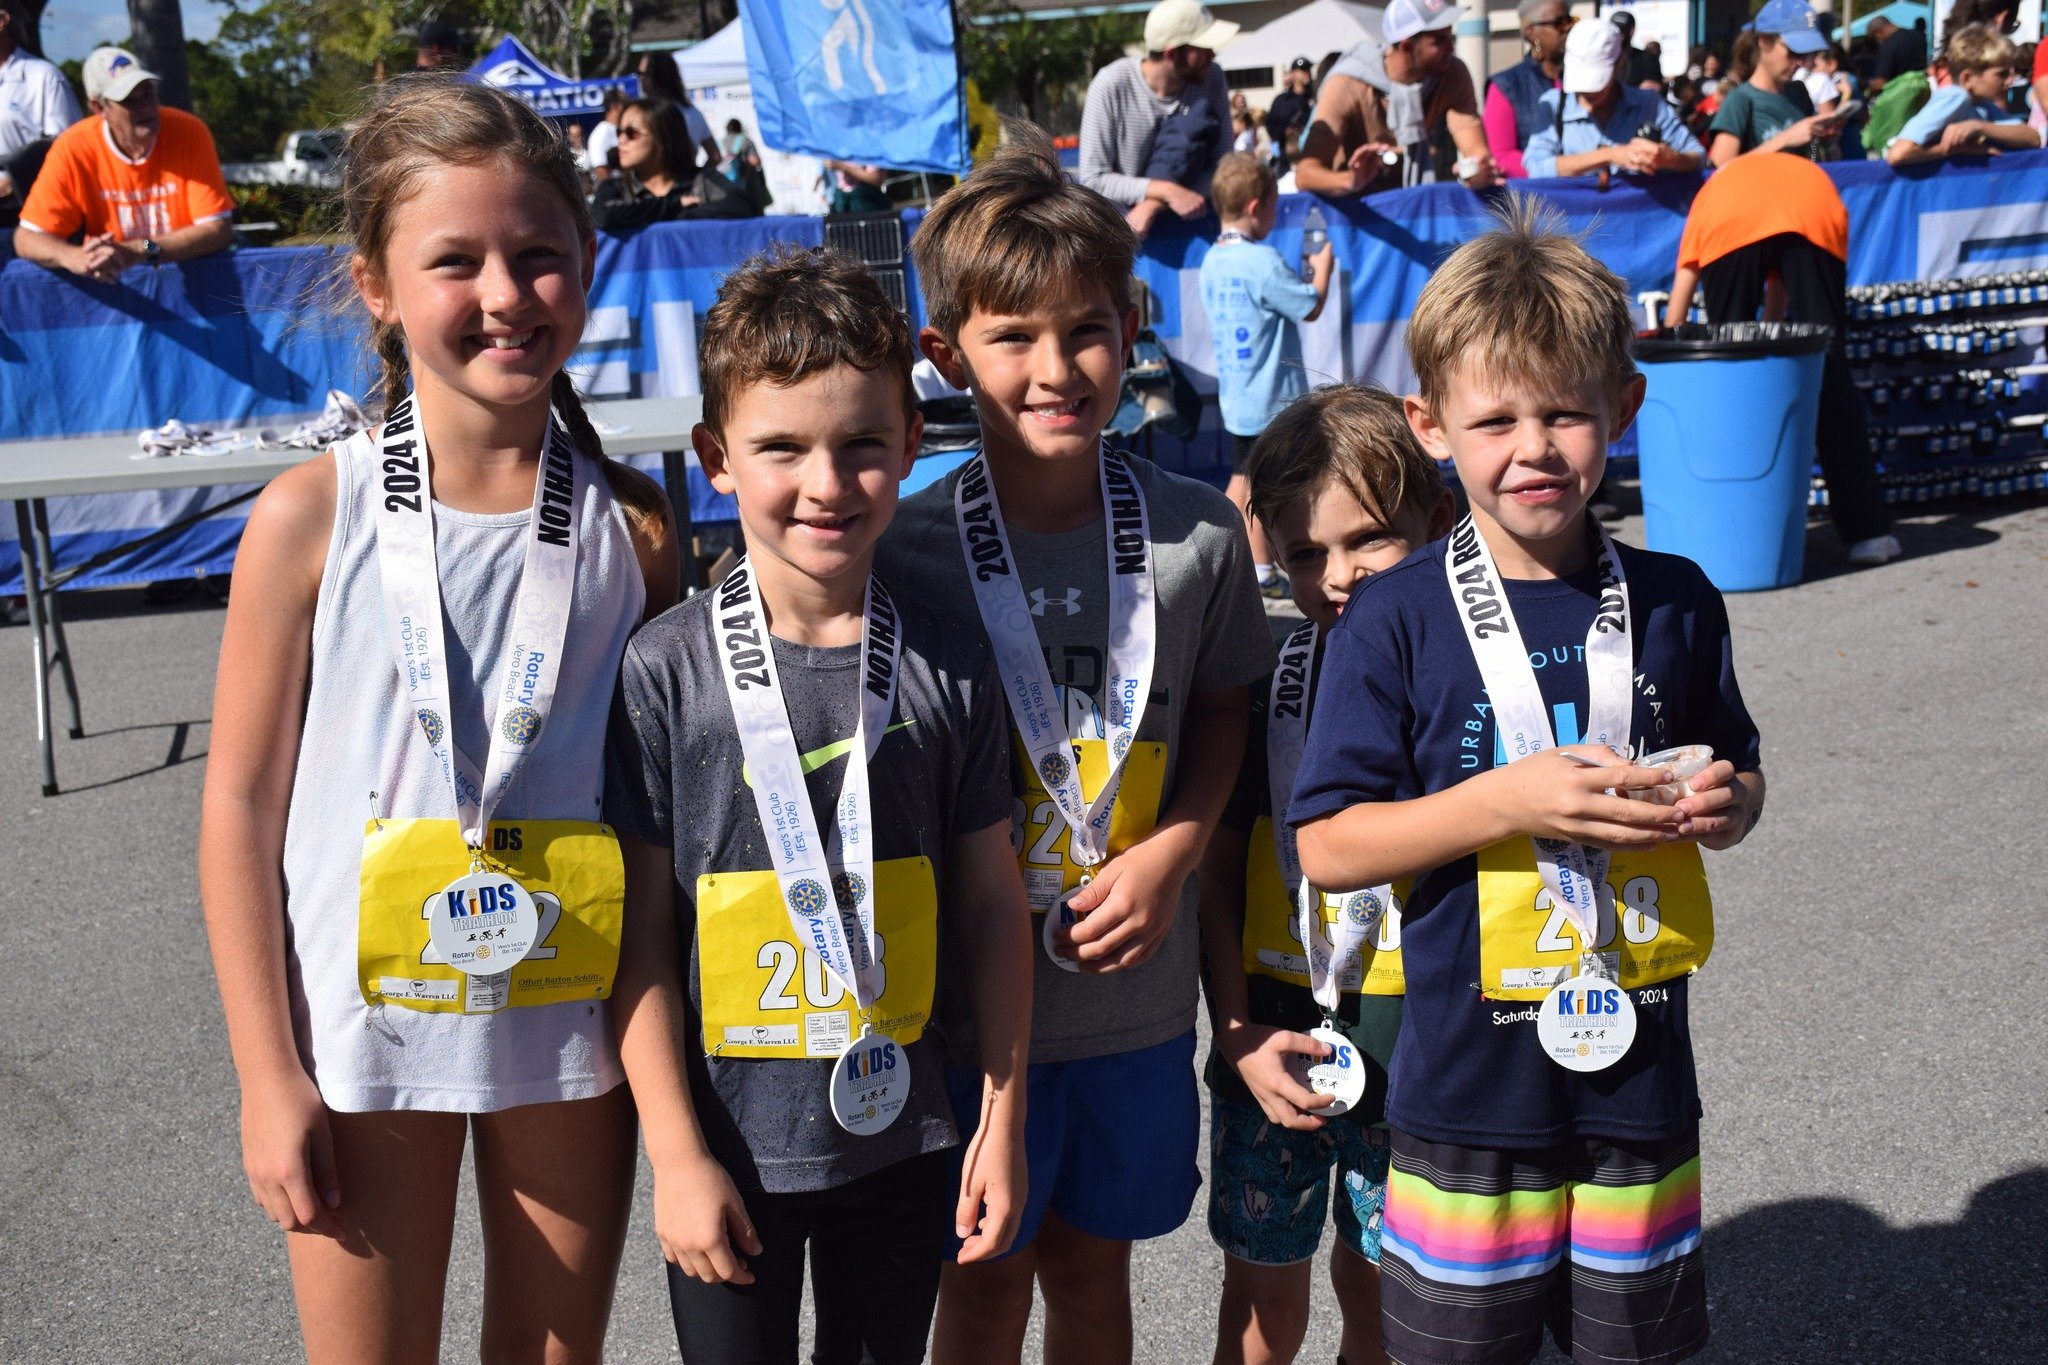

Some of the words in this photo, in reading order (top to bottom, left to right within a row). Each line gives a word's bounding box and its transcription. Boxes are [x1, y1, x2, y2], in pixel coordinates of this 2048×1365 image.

[522, 82, 626, 111] ATIO
[383, 392, 415, 439] RO
[382, 439, 422, 513] 2024
[961, 452, 989, 505] RO
[962, 501, 1011, 582] 2024
[720, 557, 752, 611] RO
[1455, 563, 1510, 640] 2024
[401, 616, 412, 638] Club
[404, 637, 414, 658] 1st
[416, 627, 429, 656] 1926)
[721, 610, 772, 691] 2024
[419, 657, 432, 681] (Est.
[511, 643, 526, 668] Vero
[1528, 645, 1585, 669] OUT
[408, 659, 418, 692] Vero's
[504, 668, 521, 703] Beach
[517, 650, 546, 707] Rotary
[1015, 675, 1028, 697] Club
[1109, 674, 1120, 698] Vero
[1274, 650, 1309, 719] 2024
[1023, 695, 1033, 712] 1st
[1028, 681, 1045, 709] 1926)
[1120, 679, 1139, 730] Rotary
[1027, 712, 1041, 742] Vero's
[1040, 710, 1053, 729] (Est.
[1109, 699, 1120, 729] Beach
[1461, 688, 1492, 769] URBA
[1515, 732, 1528, 755] Club
[768, 792, 782, 815] Club
[847, 792, 857, 822] 1926)
[1056, 788, 1071, 814] ary
[1068, 783, 1082, 814] Beach
[775, 816, 786, 832] 1st
[784, 801, 801, 830] 1926)
[795, 831, 808, 853] (Est.
[849, 823, 859, 845] (Est.
[780, 832, 795, 864] Vero's
[1554, 853, 1576, 904] Rotary
[1571, 850, 1586, 883] Beach
[1594, 860, 1605, 891] Beach
[1580, 884, 1591, 910] Vero
[451, 910, 518, 932] TRIATHLON
[824, 915, 842, 949] Beach
[859, 910, 869, 943] Beach
[842, 911, 857, 965] otary
[452, 951, 476, 960] Rotary
[835, 949, 849, 975] Vero
[859, 944, 869, 971] Vero
[1318, 952, 1334, 976] Club
[544, 976, 572, 984] Barton
[1501, 981, 1524, 989] George
[1639, 988, 1669, 1005] 2024
[1493, 1005, 1539, 1026] Saturda
[1558, 1015, 1618, 1028] TRIATHLON
[725, 1038, 748, 1046] George
[1298, 1042, 1352, 1069] DS
[1555, 1046, 1576, 1054] Rotary
